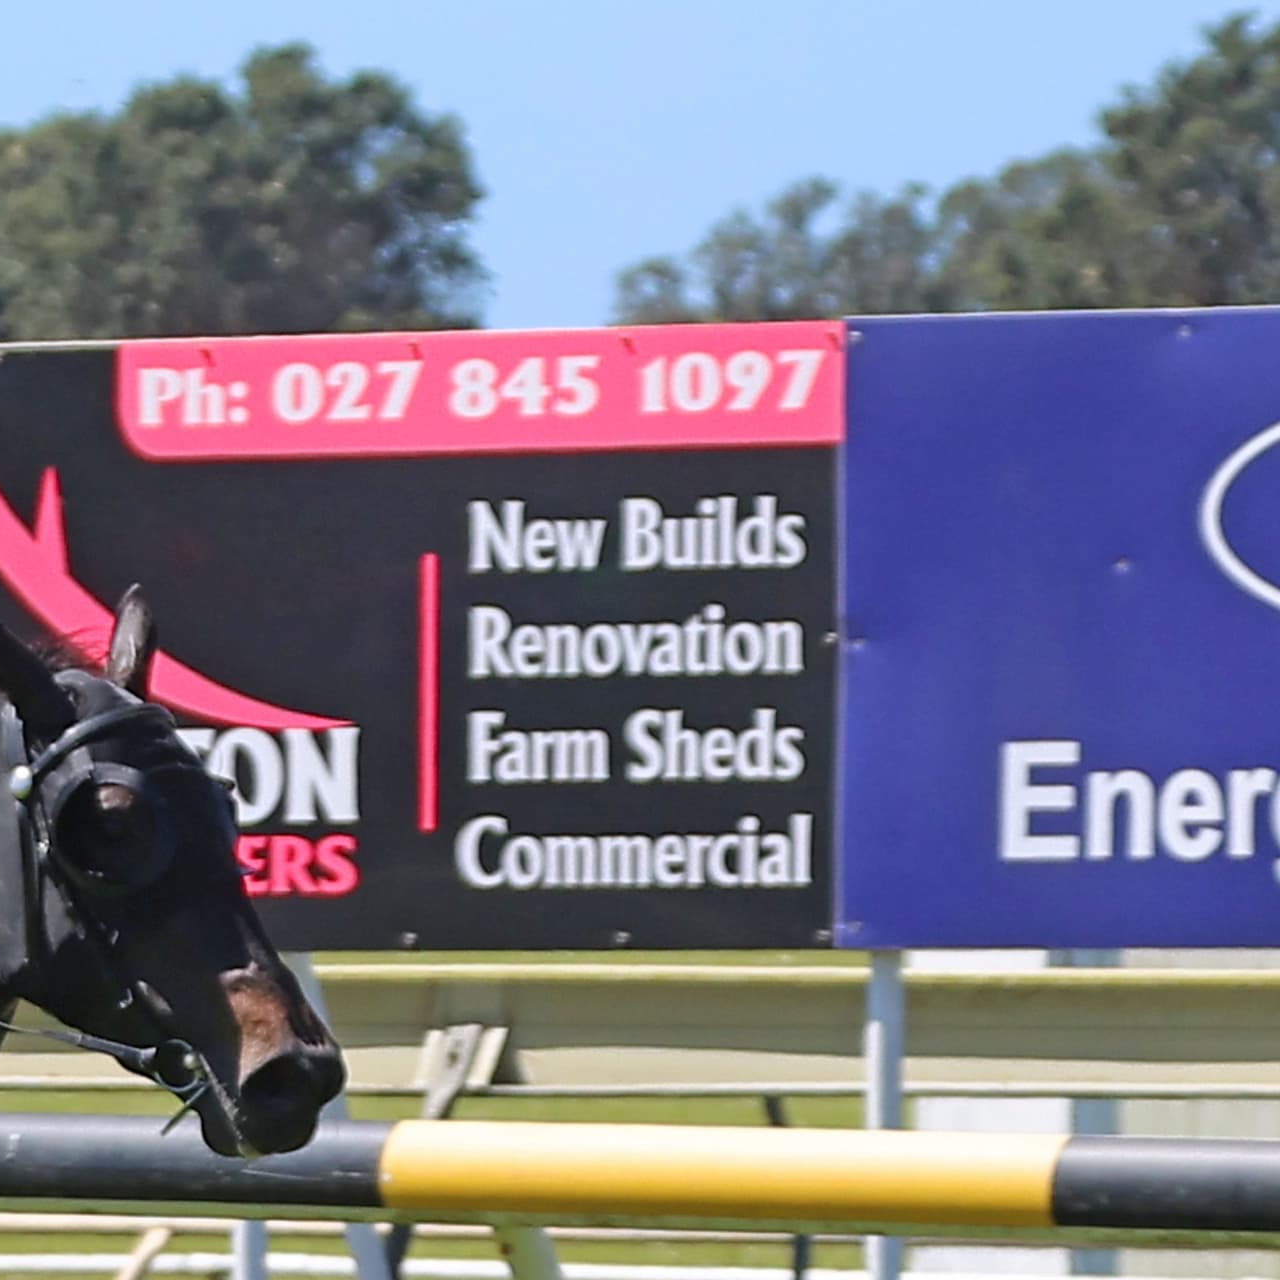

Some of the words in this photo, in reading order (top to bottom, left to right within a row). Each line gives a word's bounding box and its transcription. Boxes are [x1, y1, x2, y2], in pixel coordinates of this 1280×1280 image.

[139, 367, 249, 425] Ph:
[272, 359, 425, 423] 027
[449, 355, 600, 418] 845
[640, 349, 826, 414] 1097
[469, 500, 605, 573] New
[621, 495, 807, 571] Builds
[467, 604, 804, 680] Renovation
[467, 711, 610, 783] Farm
[625, 708, 806, 782] Sheds
[456, 814, 812, 889] Commercial
[998, 740, 1279, 890] Ener
